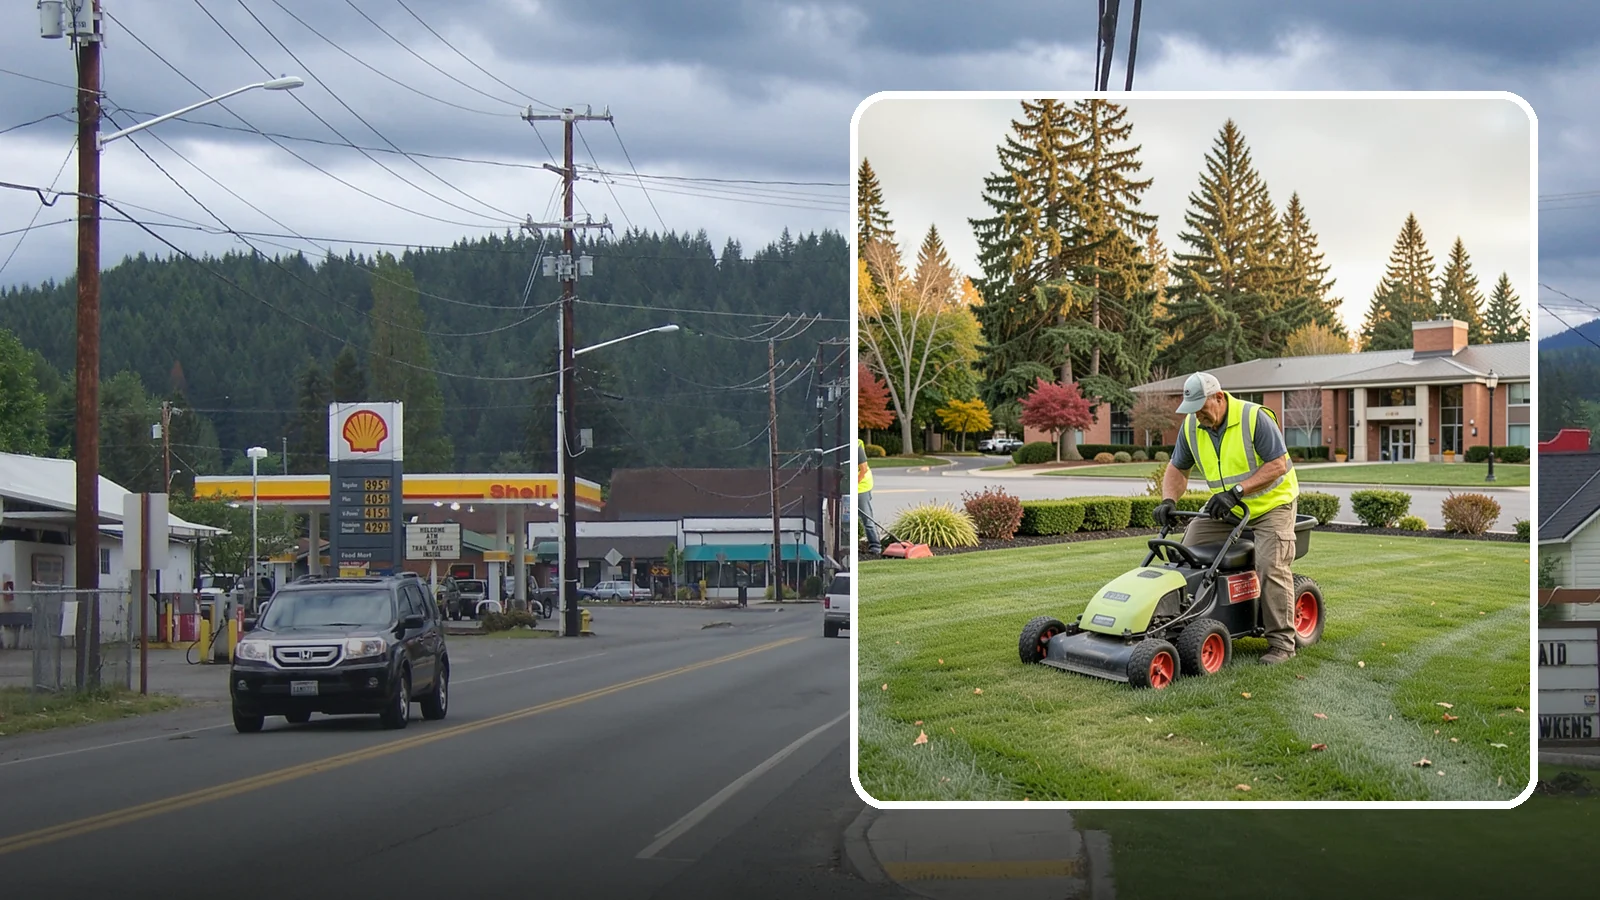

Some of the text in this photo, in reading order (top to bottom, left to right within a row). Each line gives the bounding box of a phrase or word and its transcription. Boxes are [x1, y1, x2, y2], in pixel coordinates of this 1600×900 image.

[366, 480, 383, 490] 395
[490, 484, 547, 499] Shell
[366, 494, 383, 504] 405
[366, 508, 383, 518] 415
[366, 522, 383, 532] 429
[1539, 643, 1567, 665] AID
